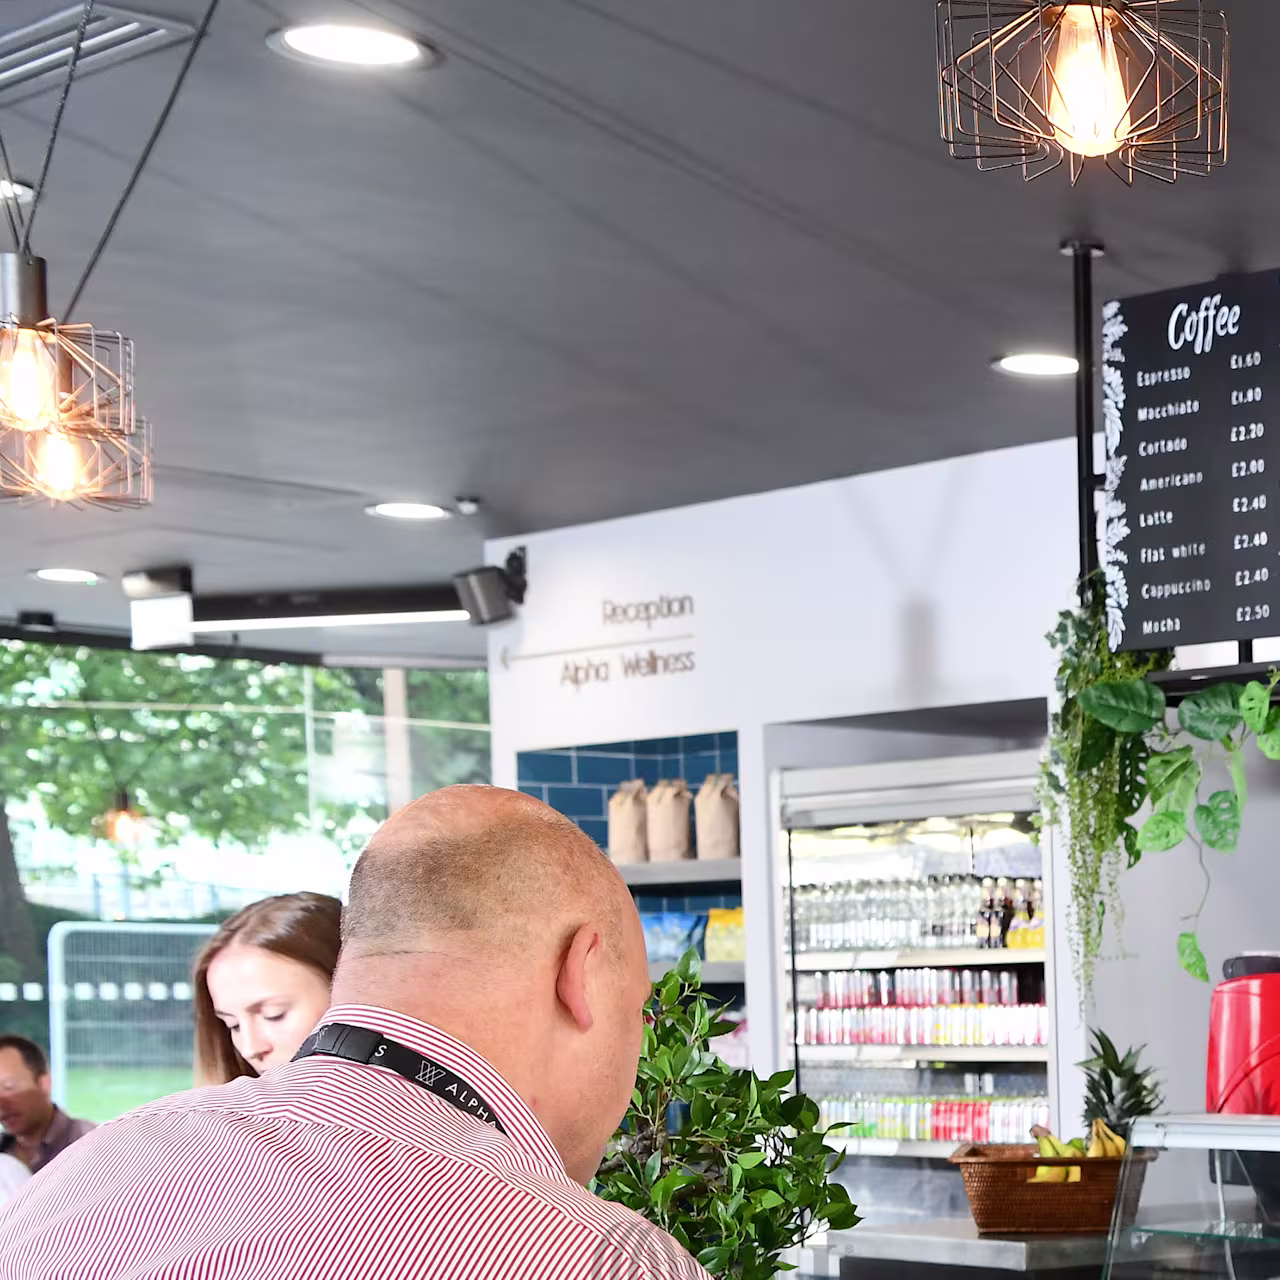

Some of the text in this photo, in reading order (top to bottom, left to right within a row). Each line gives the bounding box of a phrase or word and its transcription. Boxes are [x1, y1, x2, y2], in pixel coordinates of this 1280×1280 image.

[1168, 294, 1240, 354] Coffee
[1137, 352, 1261, 386] Espresso £1.60
[1138, 387, 1261, 421] Macchiato £1.80
[1139, 423, 1264, 456] Cortado £2.20
[1140, 459, 1264, 491] Americano £2.00
[1140, 495, 1266, 527] Latte £2.40
[1172, 544, 1205, 558] white
[1234, 532, 1267, 549] £2.40
[1142, 568, 1268, 599] Cappuccino £2.40
[602, 593, 694, 629] Reception
[1143, 605, 1269, 634] Mocha £2.50
[561, 649, 696, 691] Alpha Wellness
